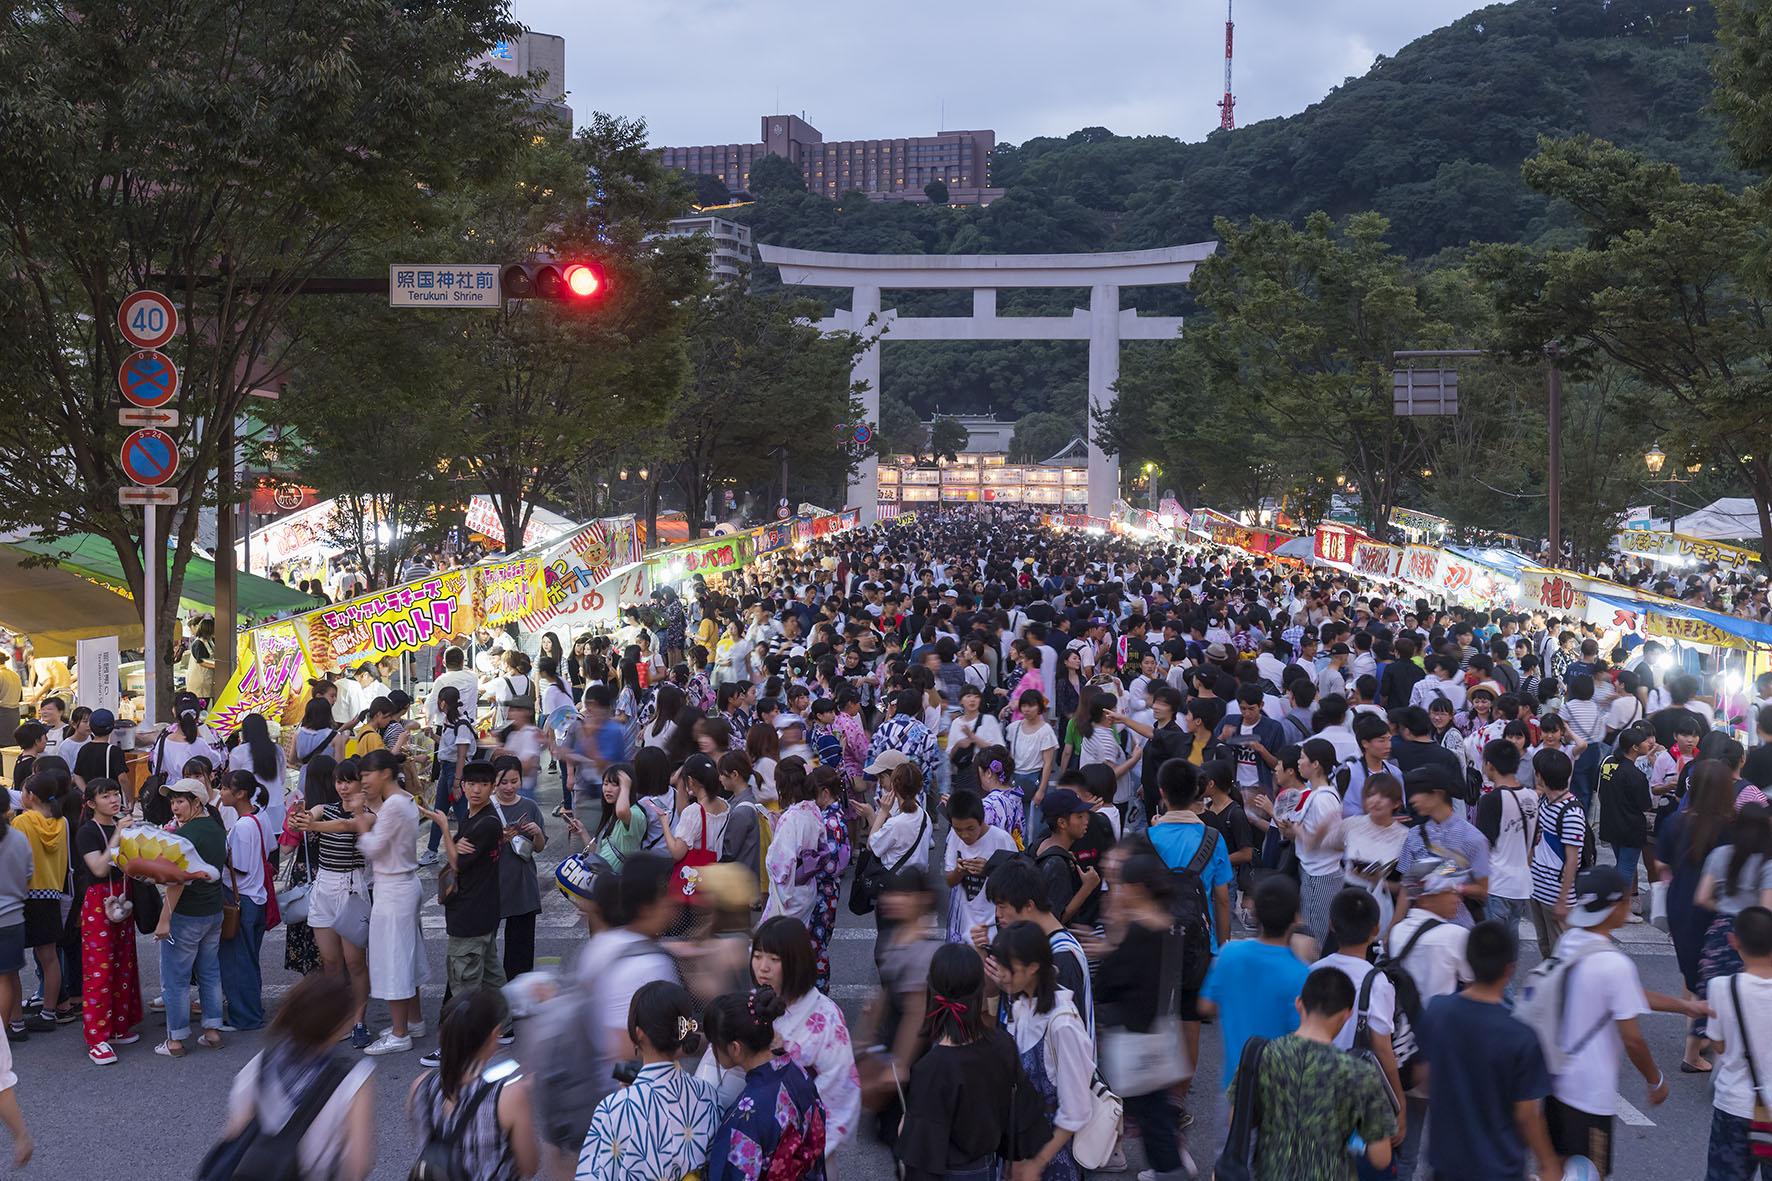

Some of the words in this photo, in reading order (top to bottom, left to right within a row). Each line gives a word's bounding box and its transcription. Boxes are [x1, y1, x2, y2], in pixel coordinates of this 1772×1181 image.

[397, 271, 493, 289] 照国神社前
[408, 291, 448, 301] Terukuni
[453, 291, 483, 301] Shrine
[132, 307, 164, 332] 40
[1679, 540, 1747, 570] レモネード
[547, 565, 593, 605] ポテト
[371, 595, 458, 653] ハットグ
